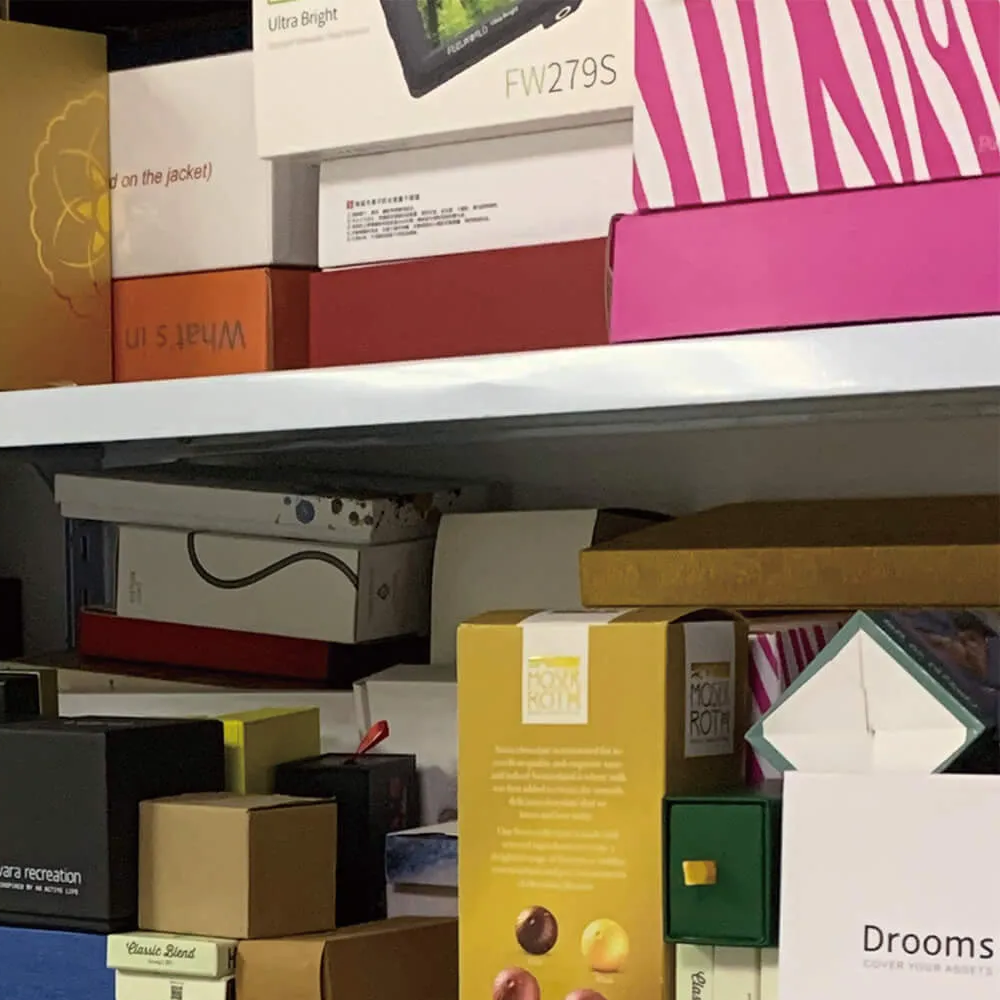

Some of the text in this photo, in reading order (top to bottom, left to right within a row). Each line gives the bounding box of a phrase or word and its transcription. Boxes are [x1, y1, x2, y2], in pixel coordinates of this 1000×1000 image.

[268, 8, 339, 32] Ultra Bright
[505, 54, 617, 99] FW279S
[121, 173, 138, 188] on
[142, 168, 163, 185] the
[165, 161, 213, 188] jacket)
[24, 867, 82, 885] recreation
[126, 941, 197, 959] Classic Blend
[863, 924, 995, 960] Drooms
